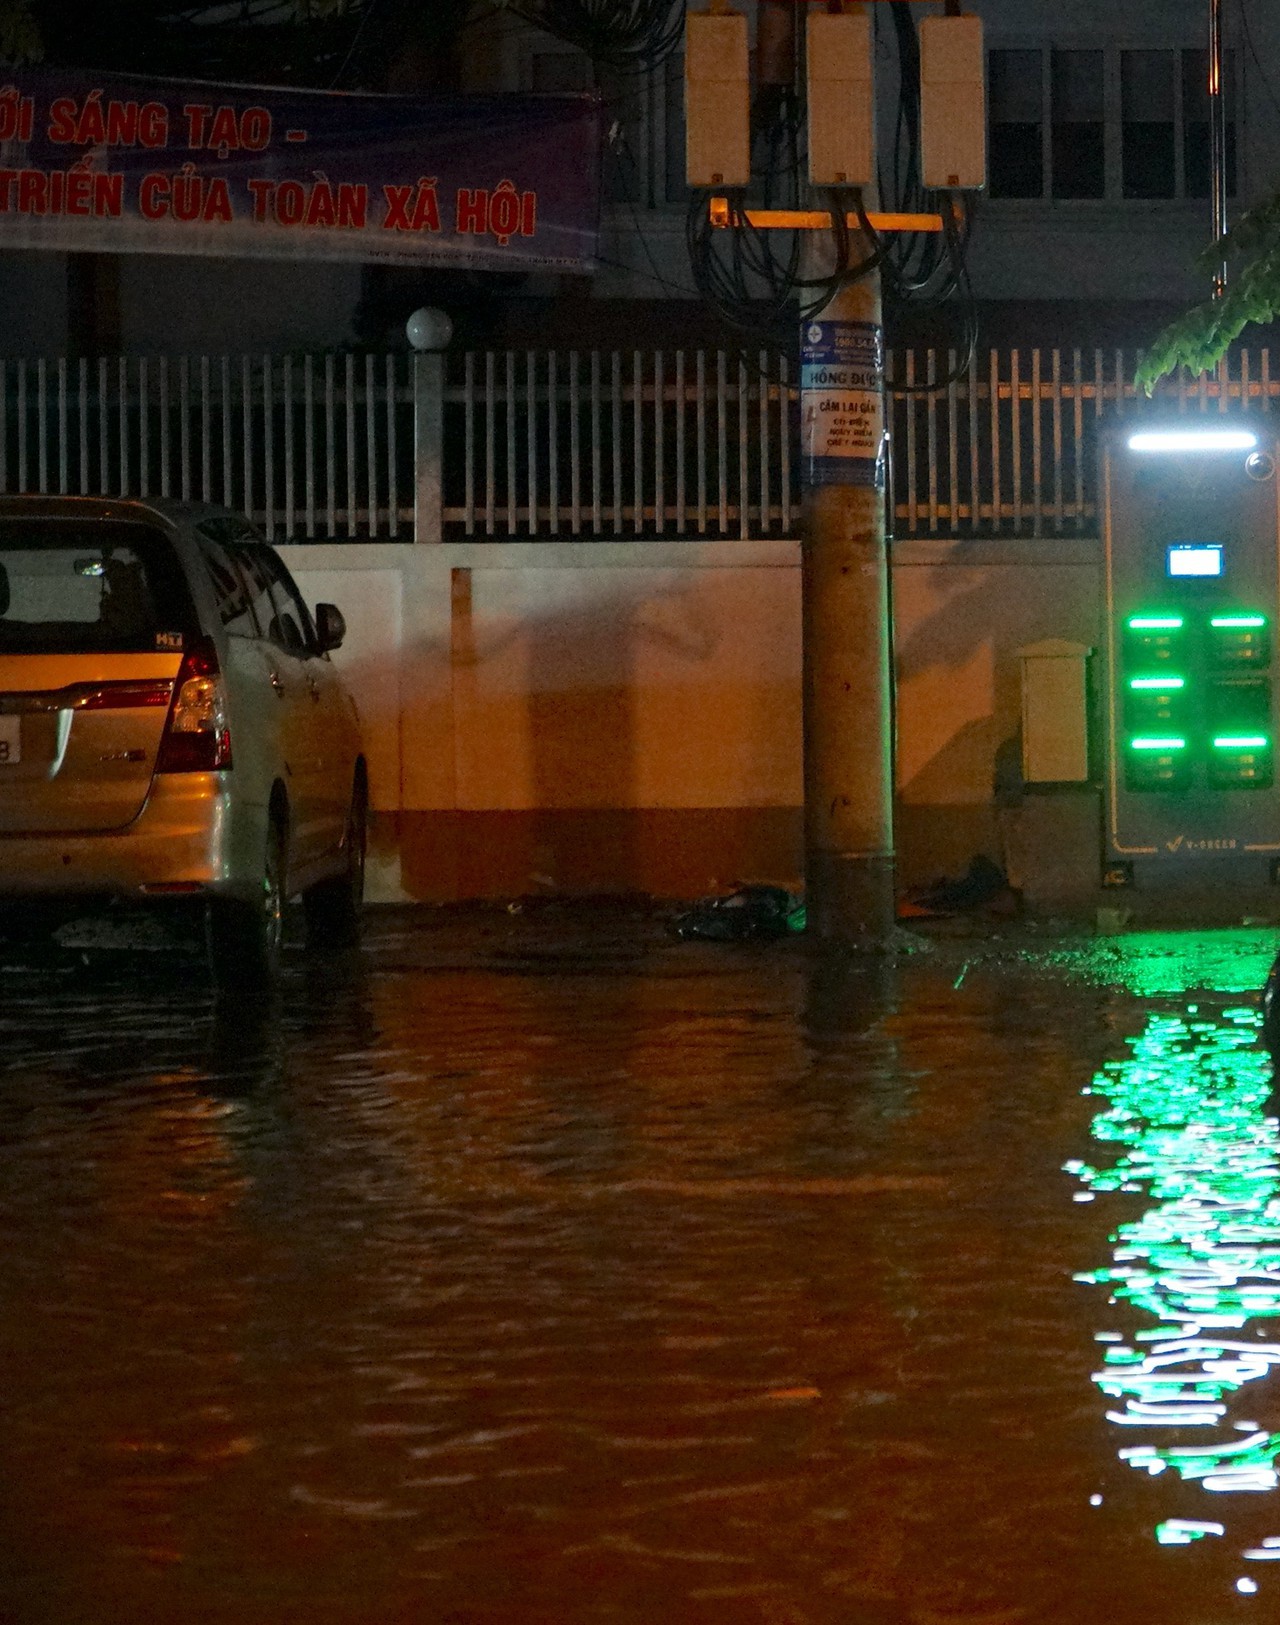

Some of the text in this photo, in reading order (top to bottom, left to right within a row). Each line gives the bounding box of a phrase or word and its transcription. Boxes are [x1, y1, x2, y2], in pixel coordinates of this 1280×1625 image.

[48, 89, 168, 148] SÁNG
[184, 105, 272, 158] TẠO
[0, 155, 537, 246] TRIỂN CỦA TOÀN XÃ HỘI
